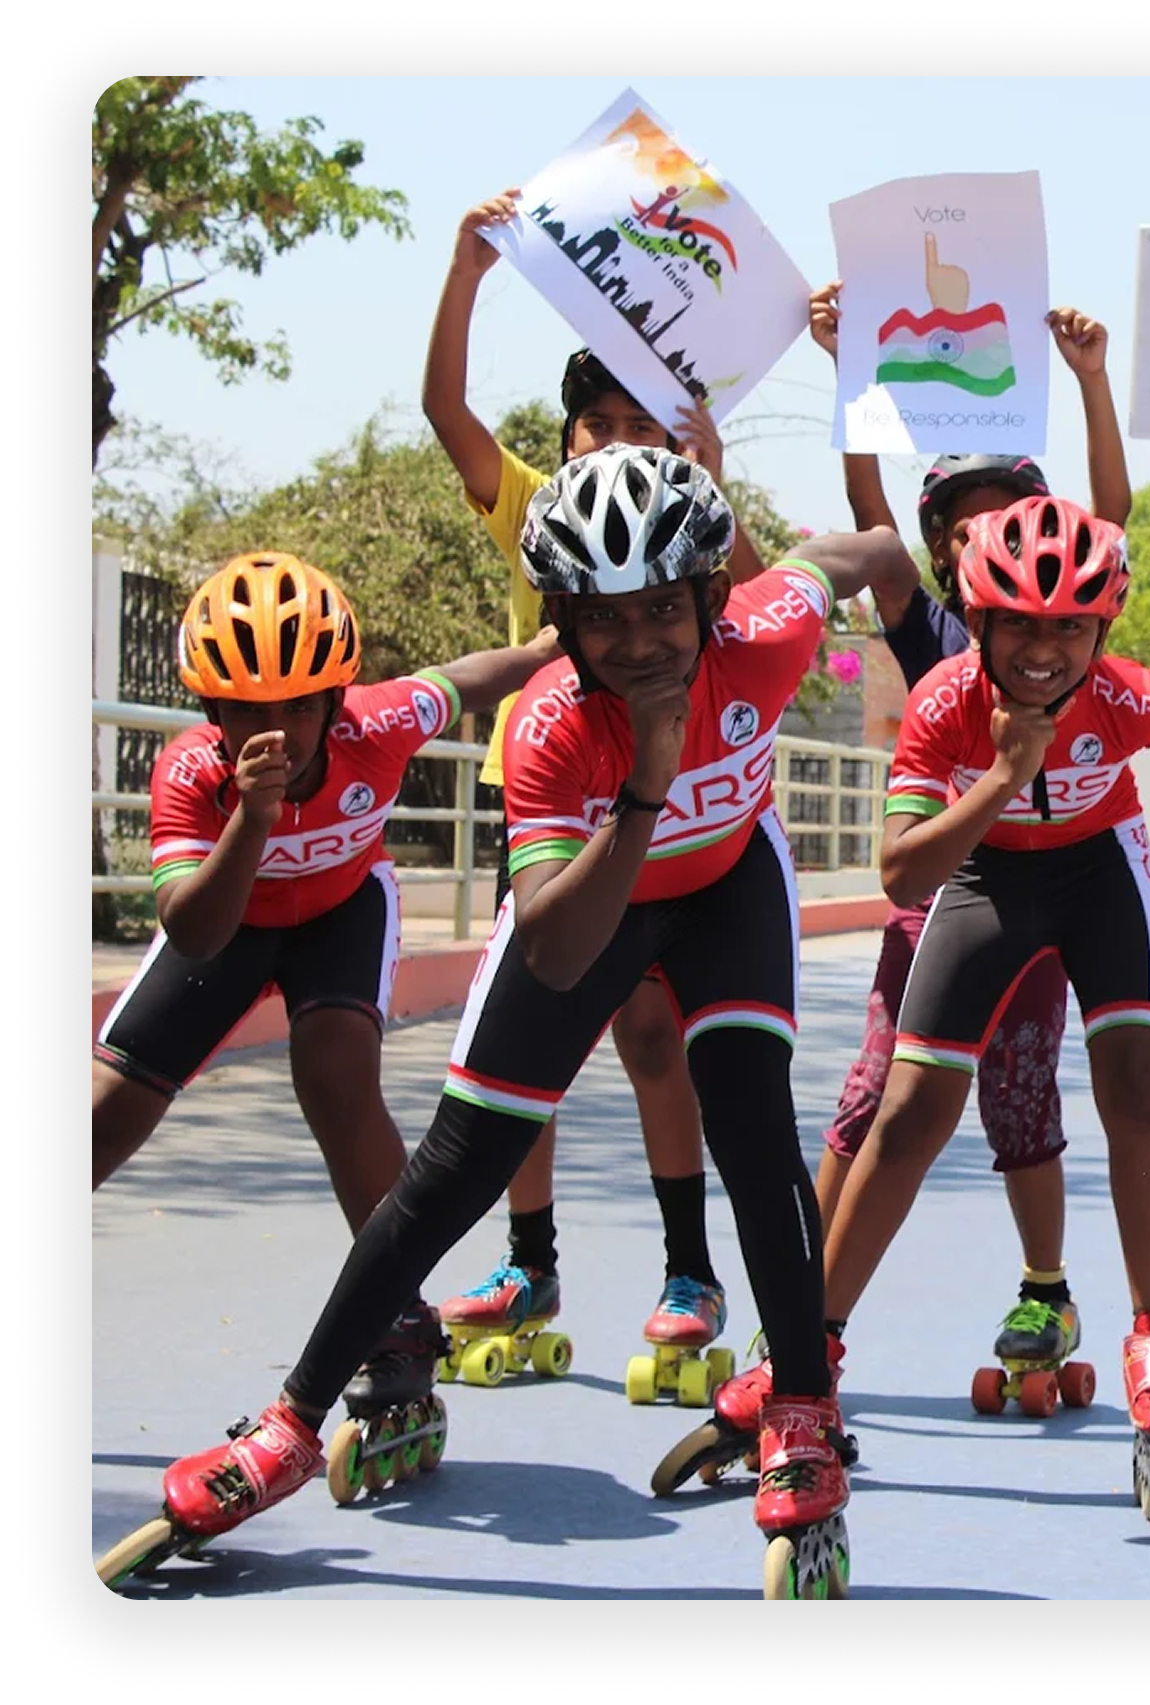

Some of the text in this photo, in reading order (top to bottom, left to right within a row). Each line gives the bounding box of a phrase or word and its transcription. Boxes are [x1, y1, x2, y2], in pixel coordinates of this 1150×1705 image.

[914, 205, 966, 223] Vote
[621, 217, 695, 300] Better India
[659, 237, 690, 272] for a
[663, 205, 722, 279] Vote
[900, 409, 1026, 429] Responsible
[259, 816, 384, 868] ARS
